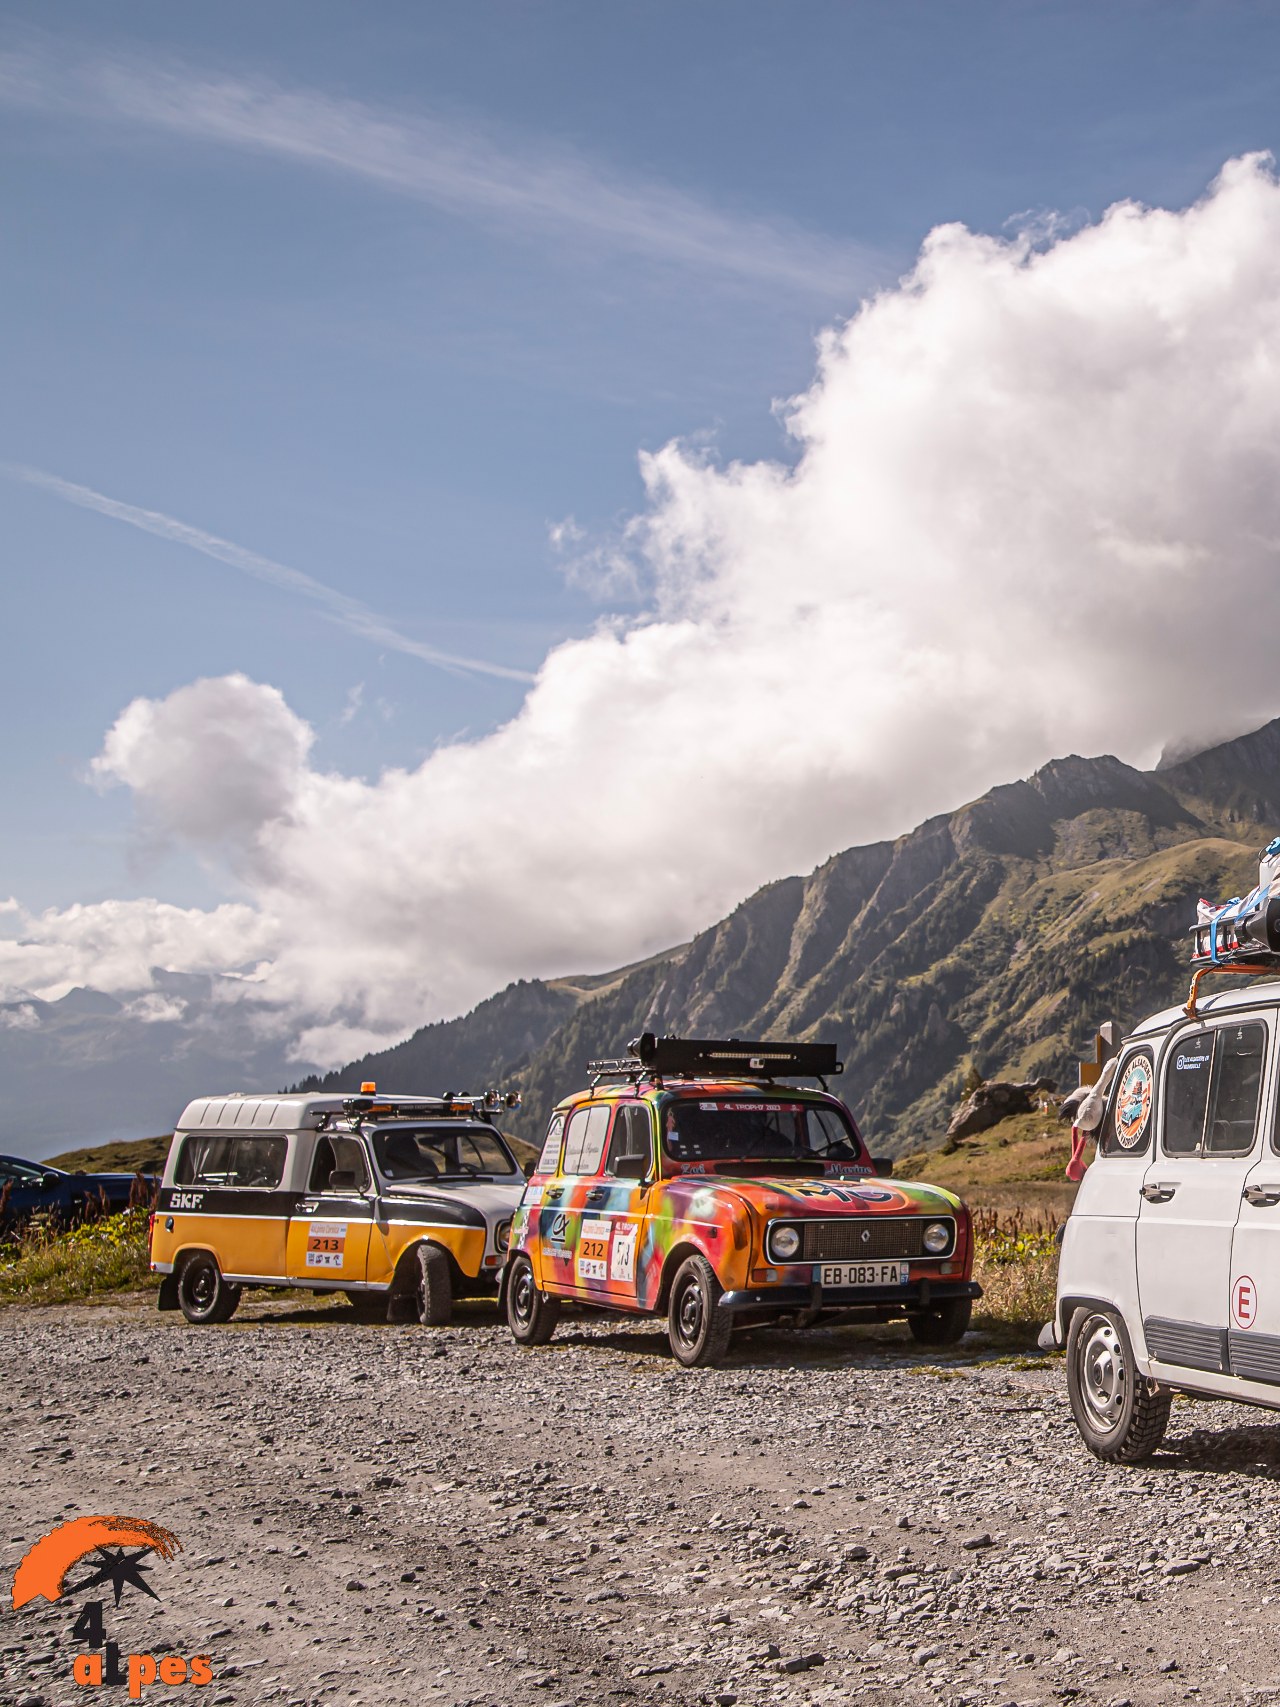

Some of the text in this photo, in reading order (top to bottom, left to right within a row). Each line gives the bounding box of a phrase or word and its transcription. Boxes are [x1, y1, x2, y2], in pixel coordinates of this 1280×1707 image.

[312, 1239, 339, 1251] 213
[583, 1241, 604, 1257] 212
[823, 1265, 898, 1285] EB-083-FA
[1238, 1286, 1251, 1319] E
